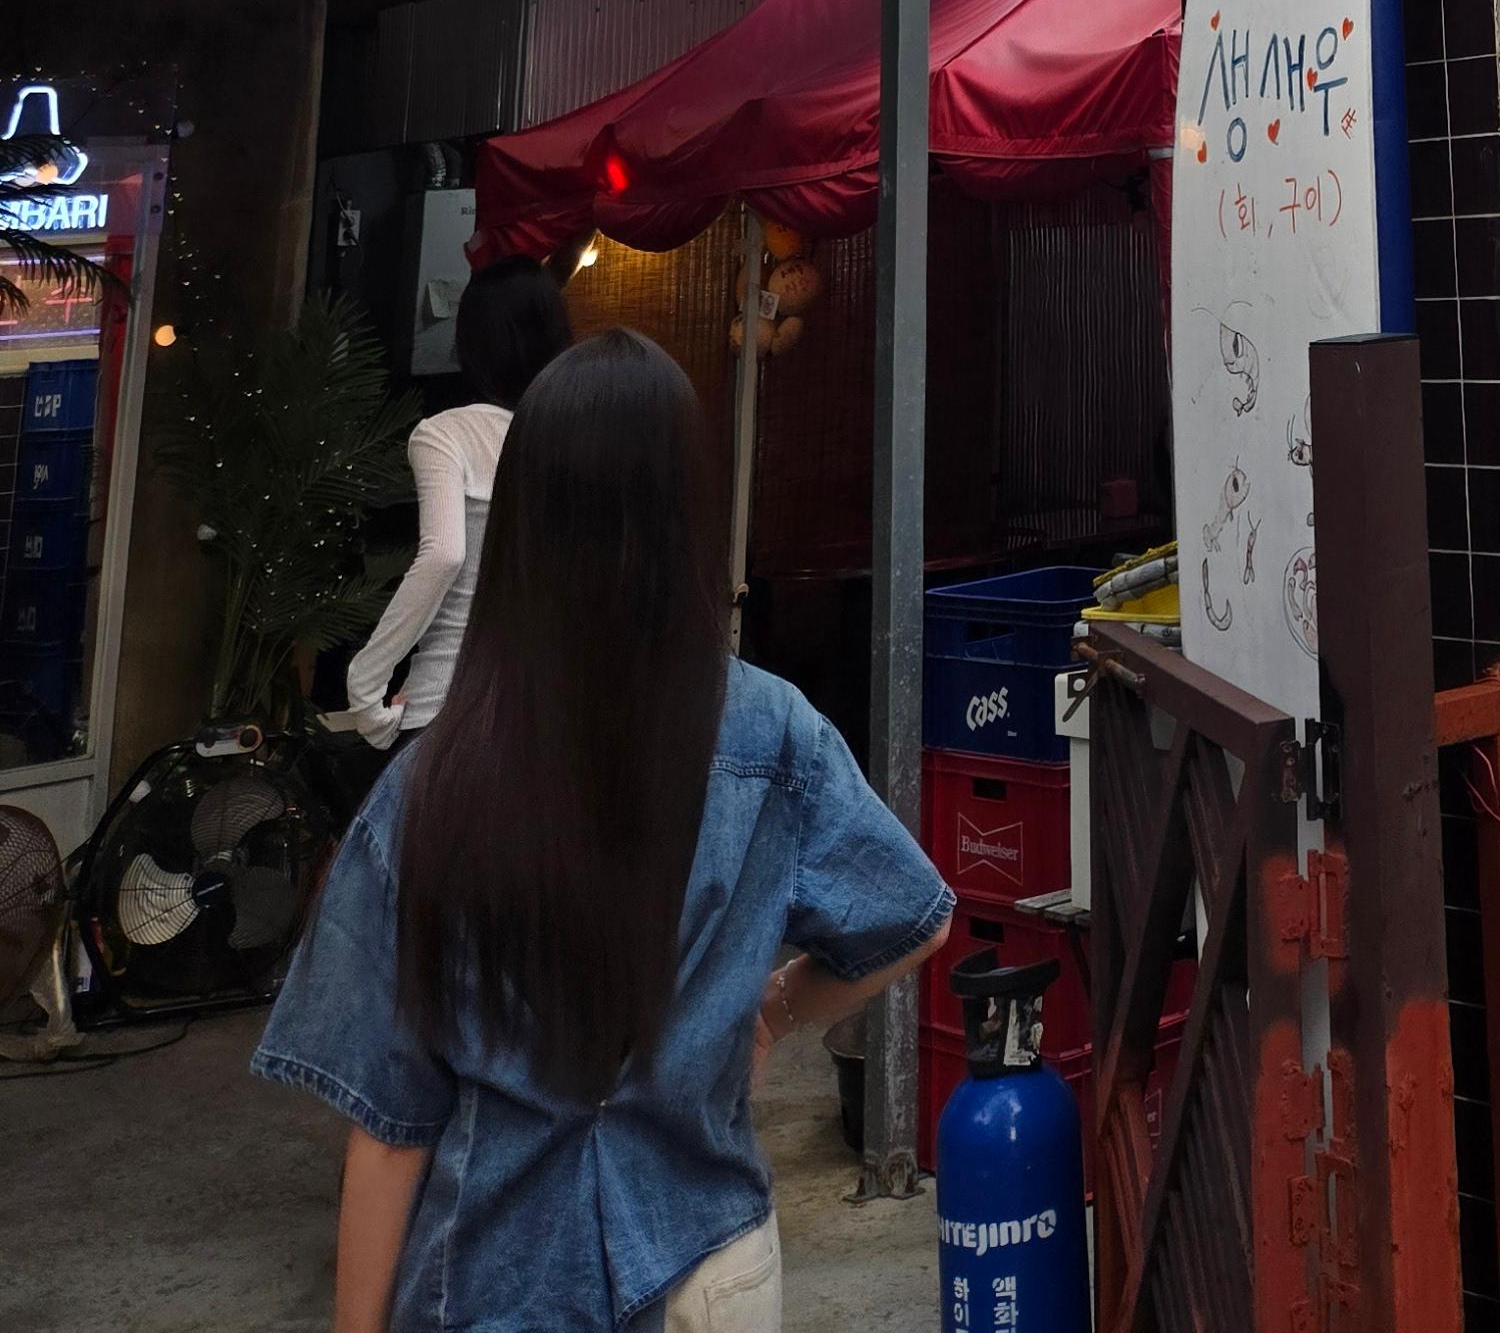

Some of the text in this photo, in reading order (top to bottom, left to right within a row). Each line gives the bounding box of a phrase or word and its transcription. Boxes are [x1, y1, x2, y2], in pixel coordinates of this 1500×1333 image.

[1198, 27, 1348, 162] 생새우
[960, 835, 1019, 861] Budweiser
[953, 1277, 970, 1333] 하이
[992, 1276, 1019, 1333] 액화
